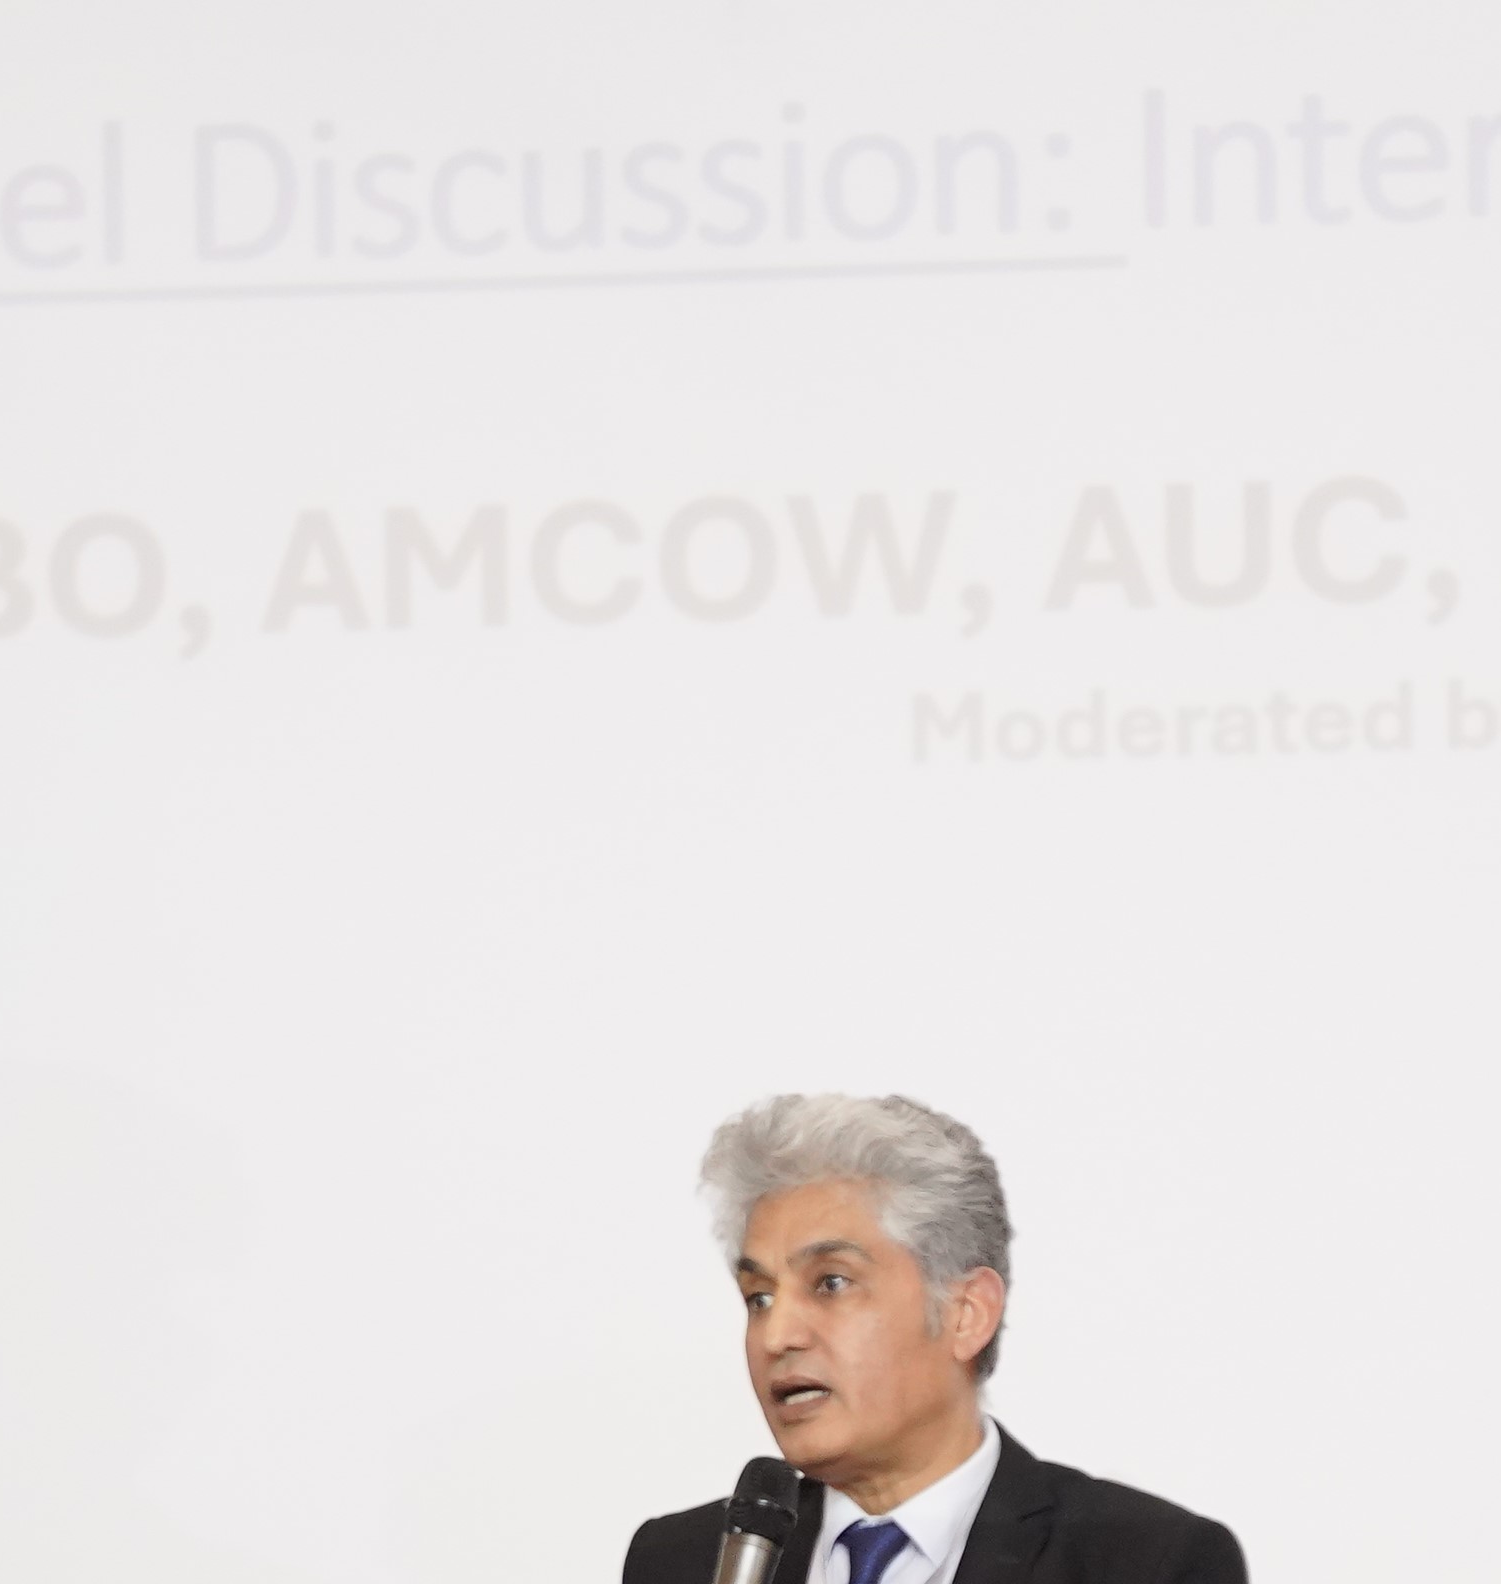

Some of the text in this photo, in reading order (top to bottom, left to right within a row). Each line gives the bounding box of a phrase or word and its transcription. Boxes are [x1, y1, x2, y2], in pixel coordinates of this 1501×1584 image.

[191, 101, 1073, 262] Discussion:
[260, 491, 994, 639] AMCOW,
[1042, 474, 1461, 627] AUC,
[910, 685, 1416, 767] Moderated
